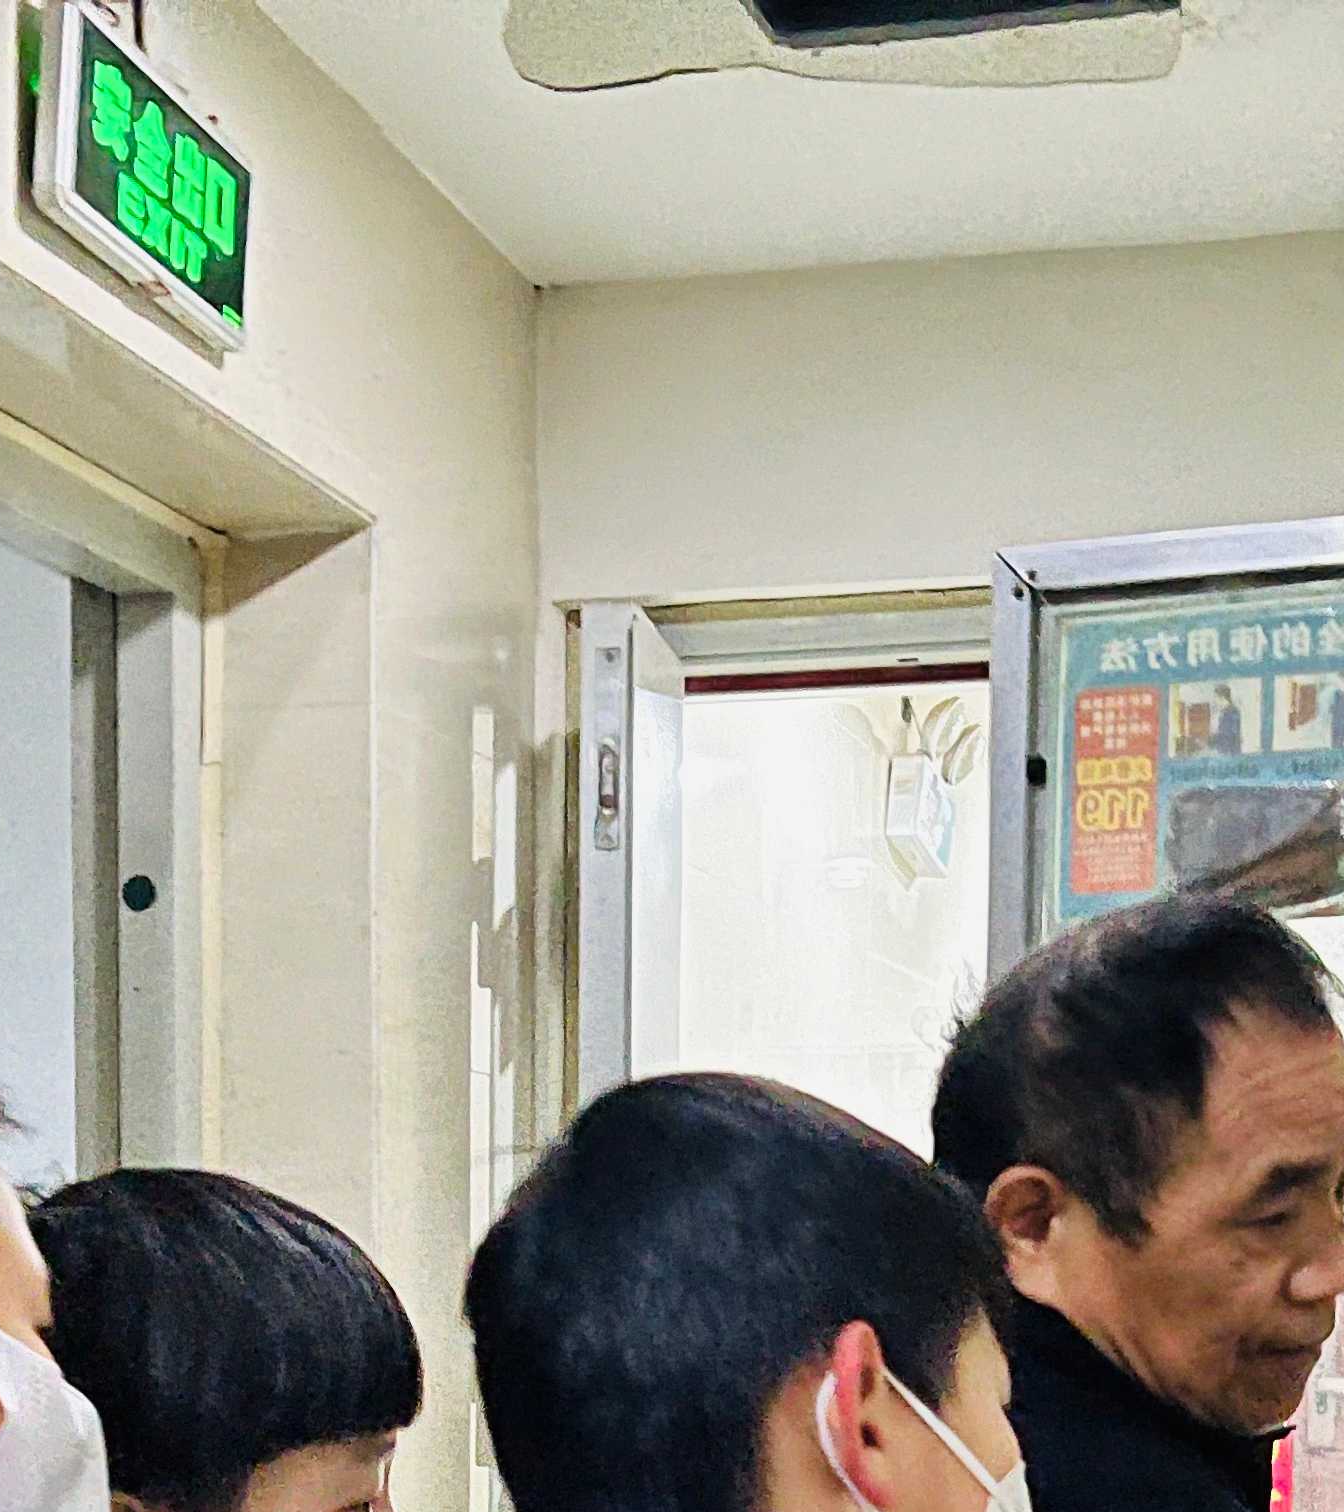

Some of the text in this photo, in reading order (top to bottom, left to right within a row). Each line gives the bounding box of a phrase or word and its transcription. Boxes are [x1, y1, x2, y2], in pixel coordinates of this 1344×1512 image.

[92, 59, 236, 256] 安全出口
[118, 172, 207, 283] EXIT
